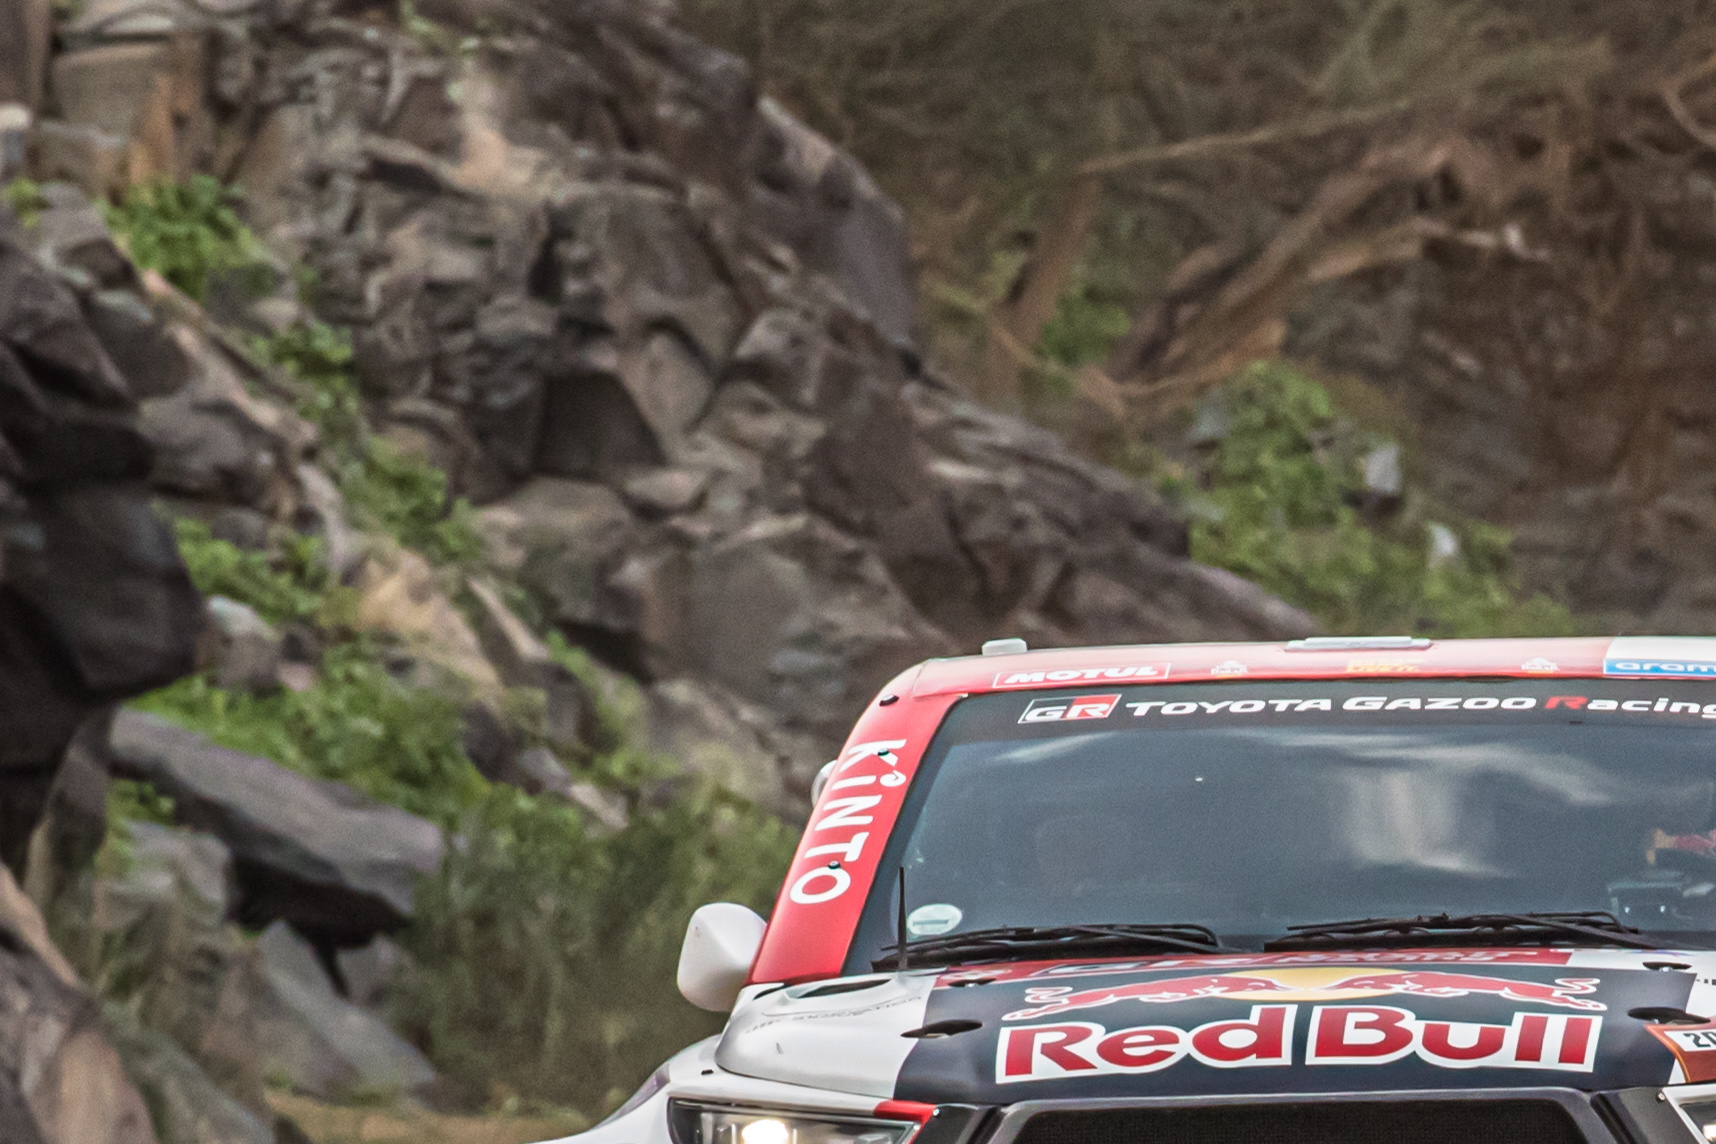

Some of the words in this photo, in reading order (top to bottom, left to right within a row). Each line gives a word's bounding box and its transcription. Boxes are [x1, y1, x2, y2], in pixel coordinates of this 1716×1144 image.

[1004, 665, 1159, 685] MOTUL
[1022, 699, 1113, 723] GR
[1126, 699, 1331, 717] TOYOTA
[1342, 696, 1538, 711] GAZOO
[1004, 1006, 1288, 1077] Red
[1313, 1006, 1594, 1065] Bull
